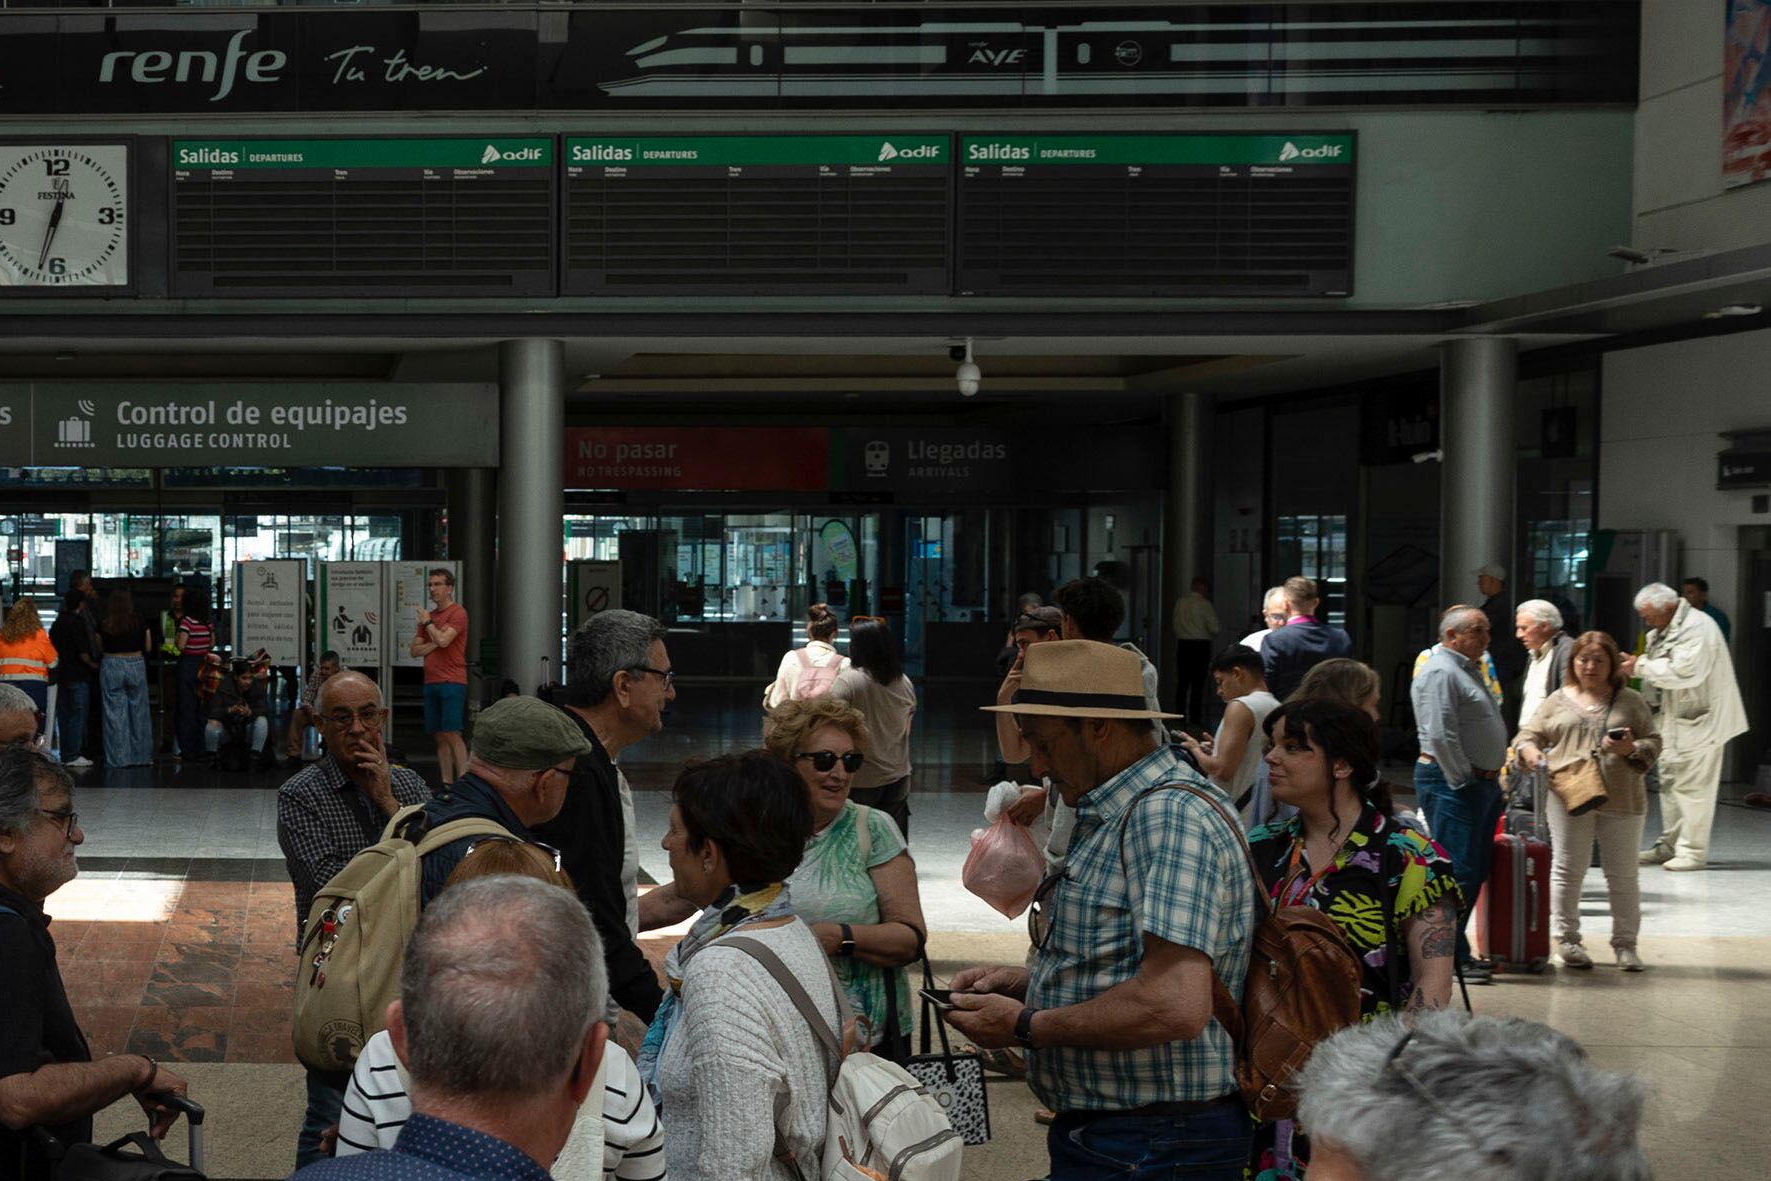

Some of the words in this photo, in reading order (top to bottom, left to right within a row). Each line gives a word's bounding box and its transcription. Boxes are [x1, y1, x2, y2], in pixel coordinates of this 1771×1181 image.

[98, 29, 288, 101] renfe
[325, 45, 376, 84] Tu
[383, 48, 482, 81] tren
[968, 48, 1028, 67] AVE
[179, 148, 239, 164] Salidas
[249, 153, 303, 162] DEPARTURES
[502, 148, 542, 160] adif
[572, 145, 633, 161] Salidas
[643, 150, 698, 159] DEPARTURES
[899, 145, 940, 158] adif
[969, 144, 1030, 160] Salidas
[1040, 149, 1096, 158] DEPARTURES
[1301, 145, 1342, 158] adif
[43, 159, 70, 176] 12
[38, 192, 76, 200] FESTINA
[0, 208, 16, 225] 9
[98, 207, 115, 225] 3
[49, 257, 66, 275] 6
[116, 400, 215, 426] Control
[226, 400, 260, 426] de
[270, 400, 408, 431] equipajes
[116, 433, 204, 449] LUGGAGE
[208, 433, 292, 449] CONTROL
[578, 440, 607, 459] No
[616, 443, 677, 463] pasar
[907, 440, 1006, 464] Llegadas
[578, 467, 594, 478] NO
[595, 467, 683, 478] TRESPASSING
[908, 467, 970, 478] ARRIVALS
